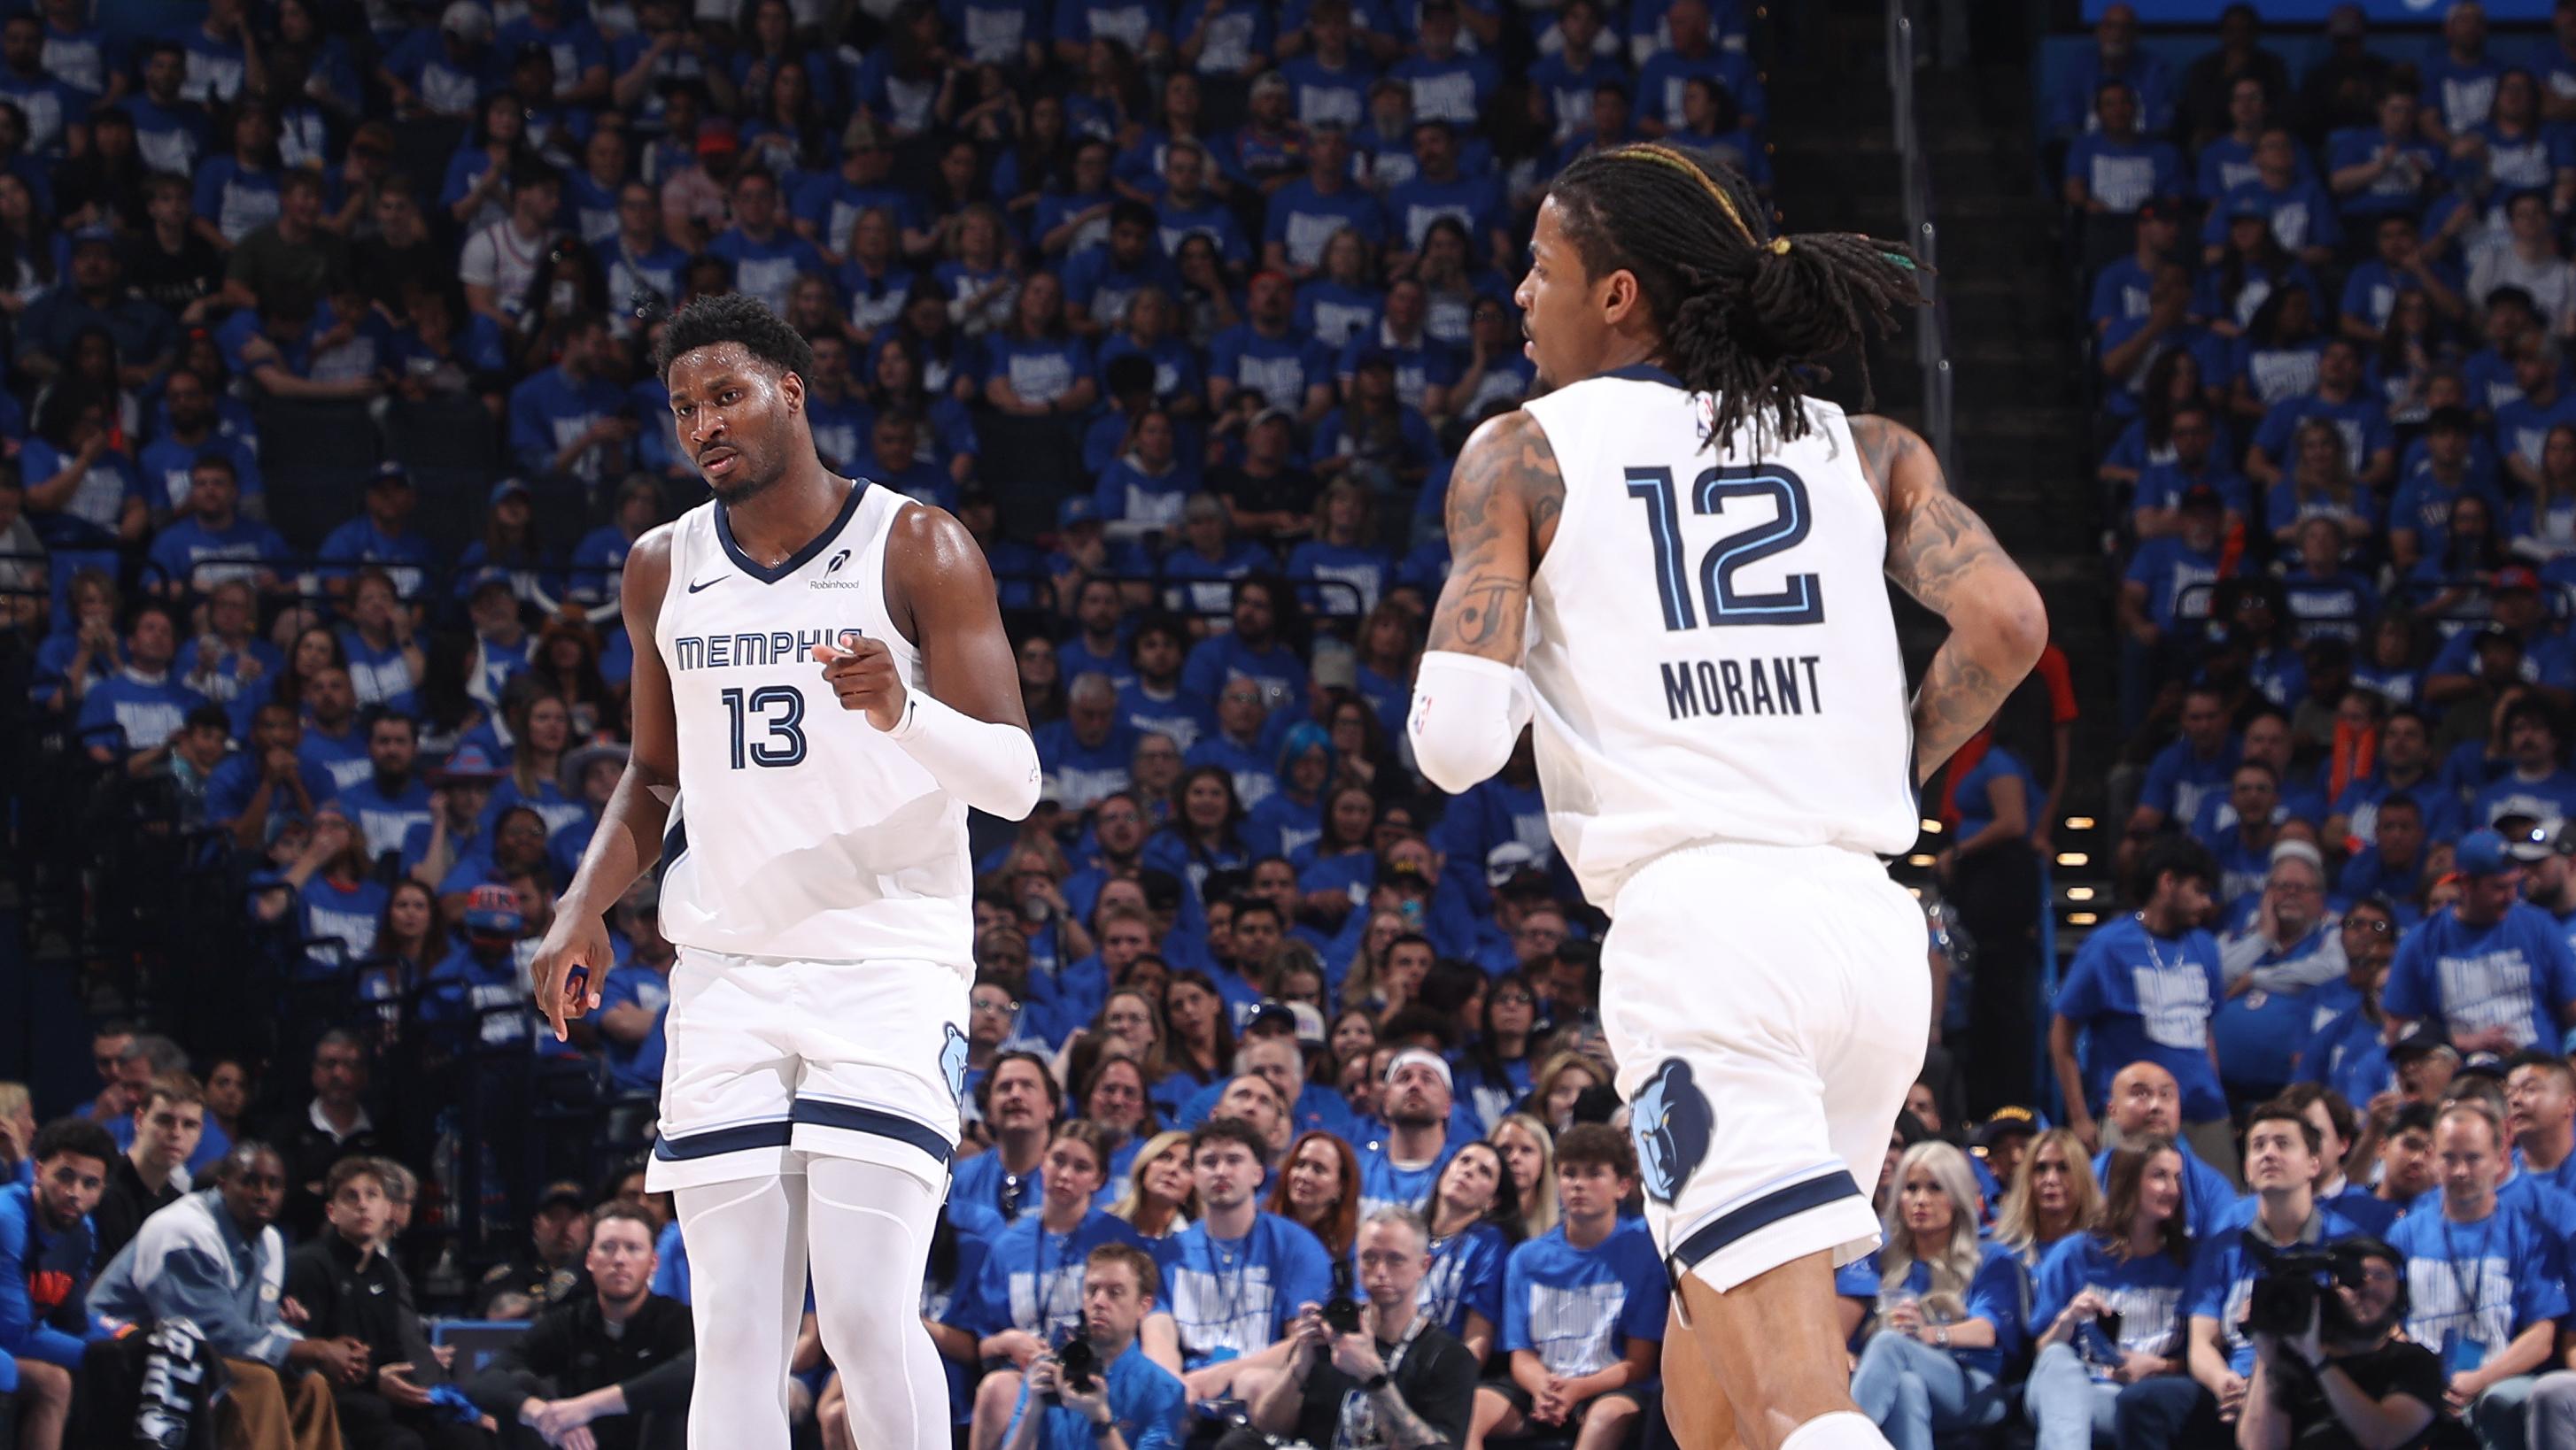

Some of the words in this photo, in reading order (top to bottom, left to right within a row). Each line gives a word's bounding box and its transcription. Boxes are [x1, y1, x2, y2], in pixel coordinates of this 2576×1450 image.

[809, 580, 860, 590] Robinhood
[1623, 463, 1826, 632] 12
[1659, 655, 1823, 721] MORANT
[721, 684, 808, 770] 13
